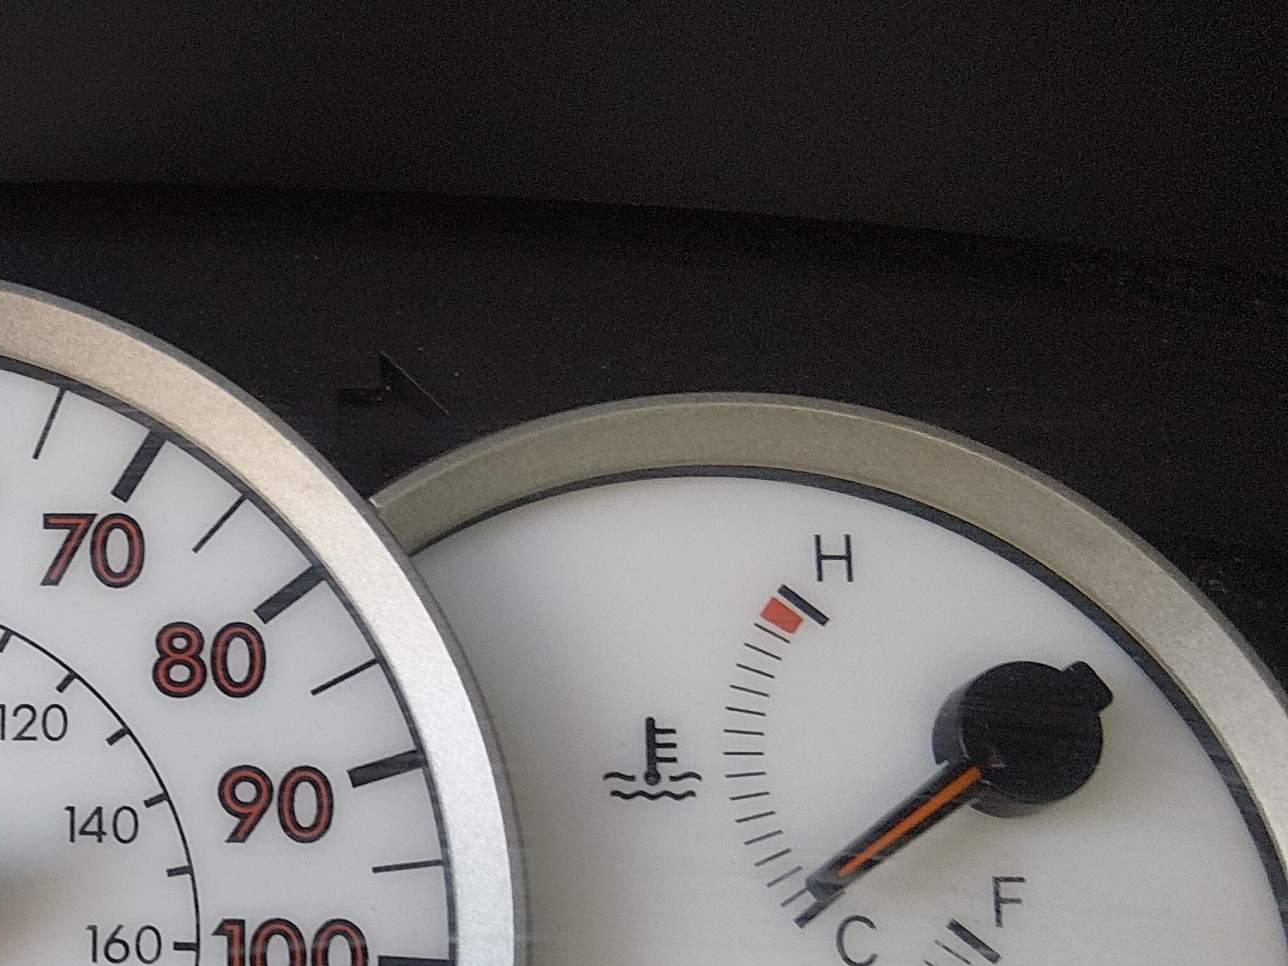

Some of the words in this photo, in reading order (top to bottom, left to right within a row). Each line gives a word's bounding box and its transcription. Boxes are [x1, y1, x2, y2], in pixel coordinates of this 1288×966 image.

[40, 512, 146, 589] 70
[815, 534, 854, 582] H
[153, 621, 267, 699] 80
[63, 805, 139, 846] 140
[217, 764, 335, 844] 90
[992, 876, 1026, 927] F
[85, 924, 162, 966] 160
